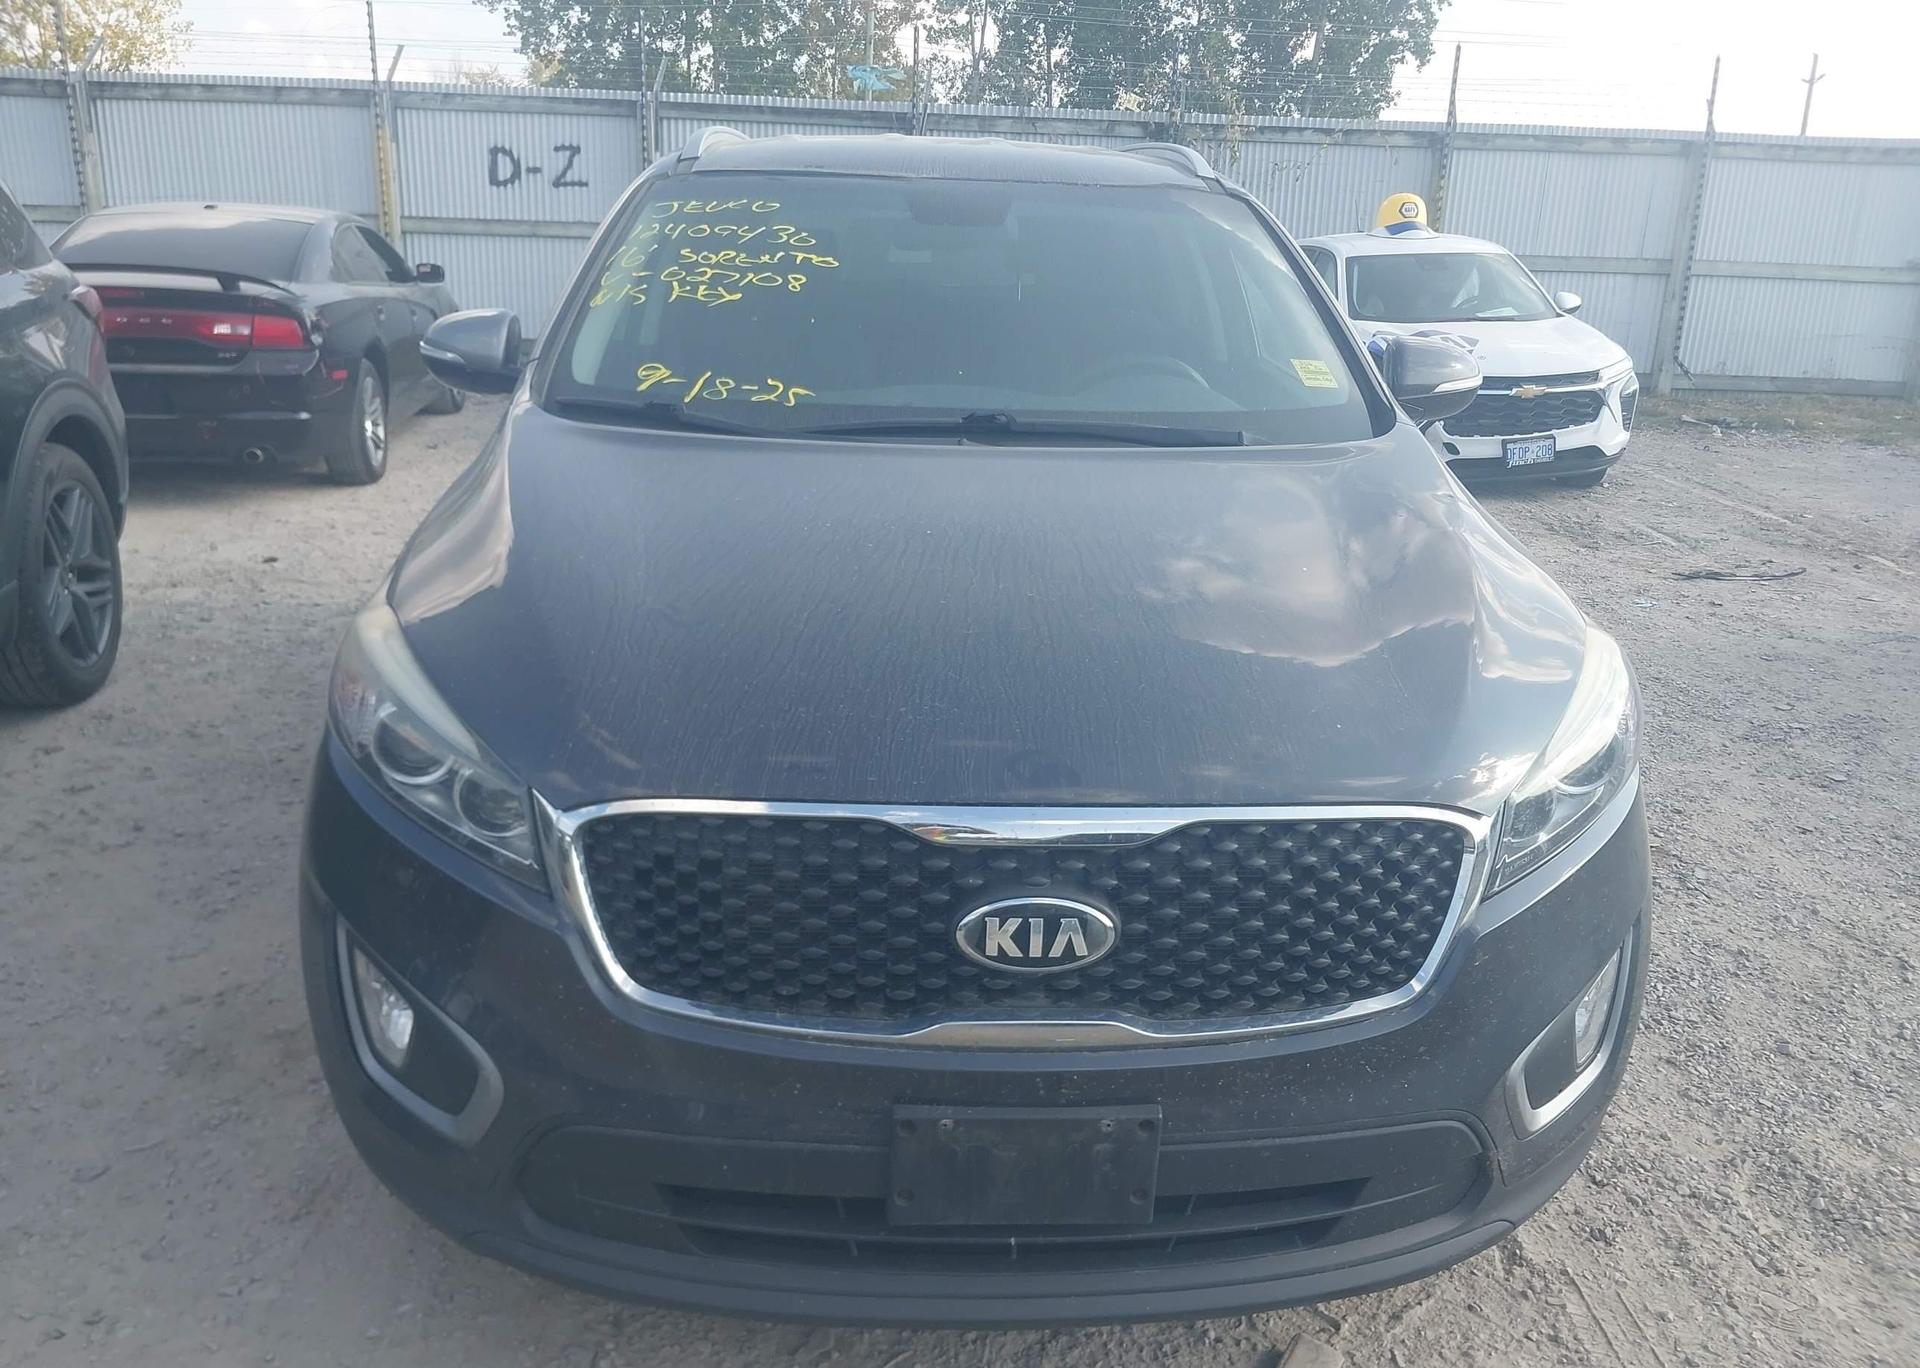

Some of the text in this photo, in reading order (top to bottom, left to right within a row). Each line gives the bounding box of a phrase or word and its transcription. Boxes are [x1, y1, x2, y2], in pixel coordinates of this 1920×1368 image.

[488, 144, 589, 189] D-Z
[667, 280, 742, 307] KEY
[984, 917, 1089, 958] KIA
